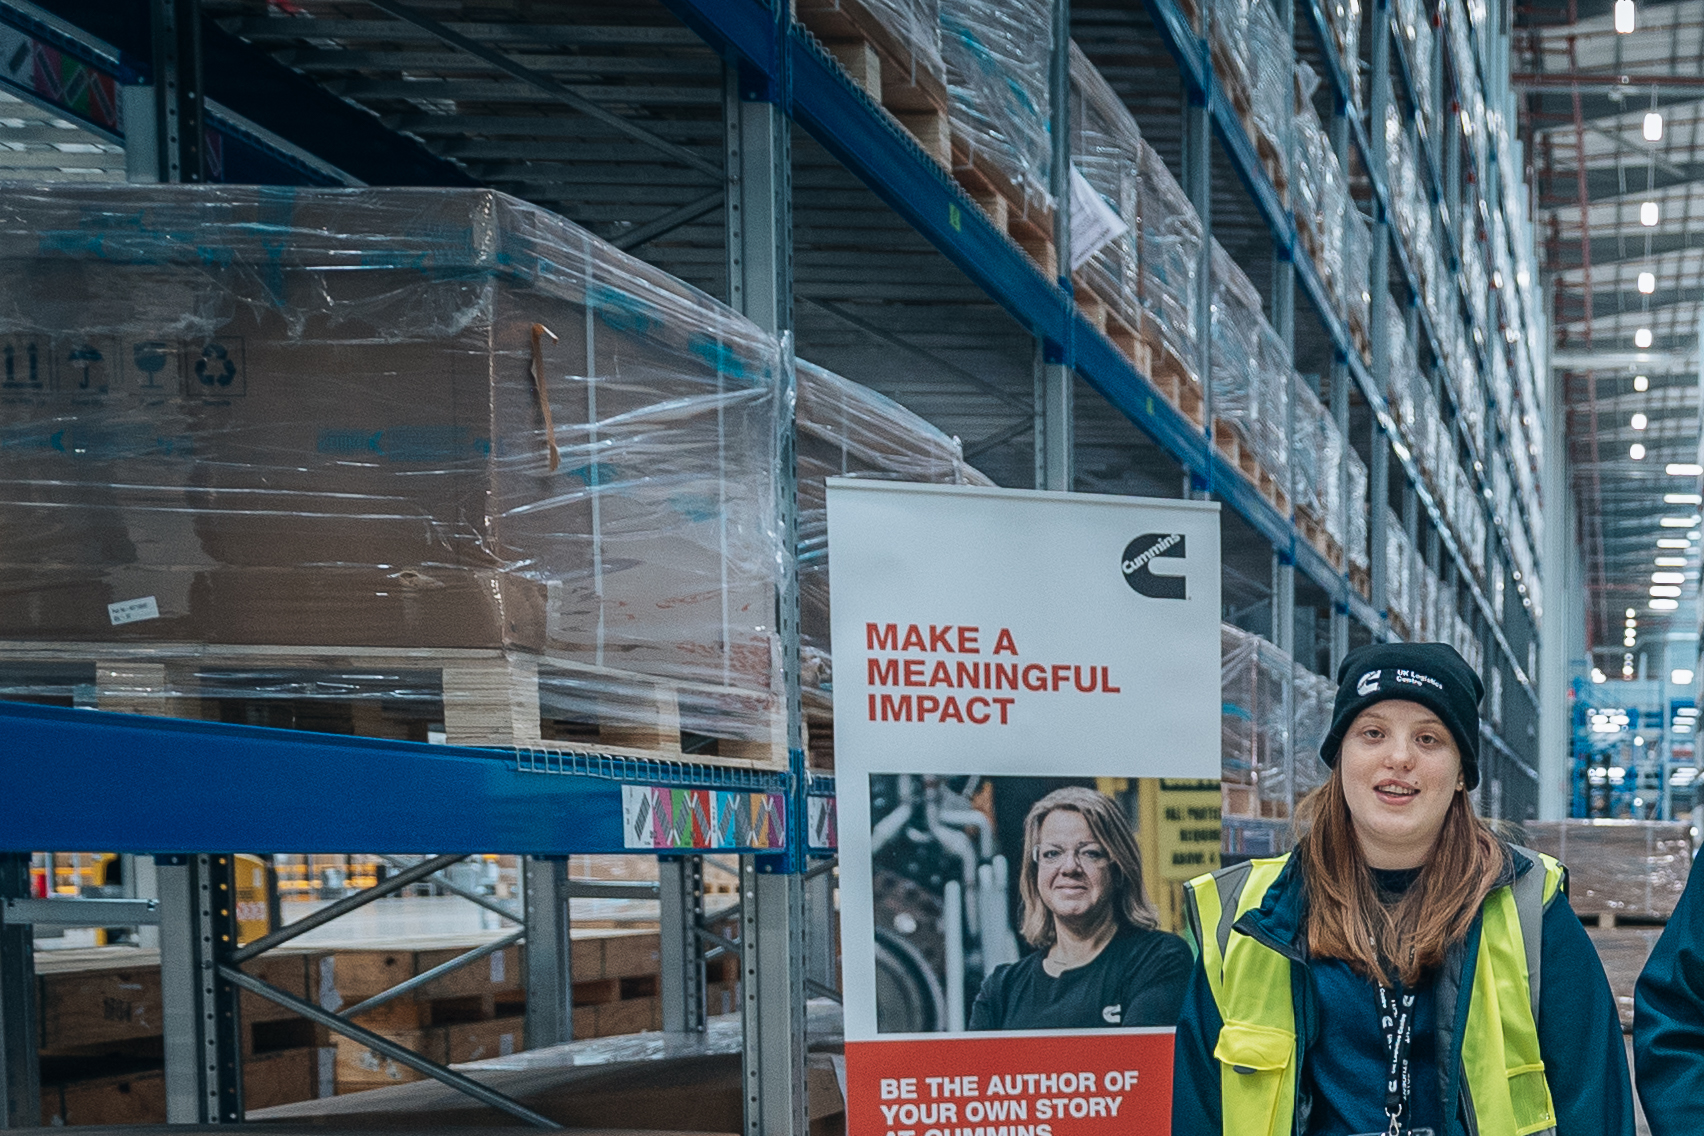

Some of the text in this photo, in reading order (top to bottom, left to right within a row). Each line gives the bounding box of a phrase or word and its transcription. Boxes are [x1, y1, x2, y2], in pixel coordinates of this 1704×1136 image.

[1121, 532, 1181, 575] Cummins
[865, 622, 1019, 656] MAKE A
[866, 658, 1121, 694] MEANINGFUL
[1396, 669, 1409, 677] UK
[868, 693, 1015, 726] IMPACT
[880, 1070, 1139, 1100] BE THE AUTHOR OF
[880, 1096, 1123, 1126] YOUR OWN STORY
